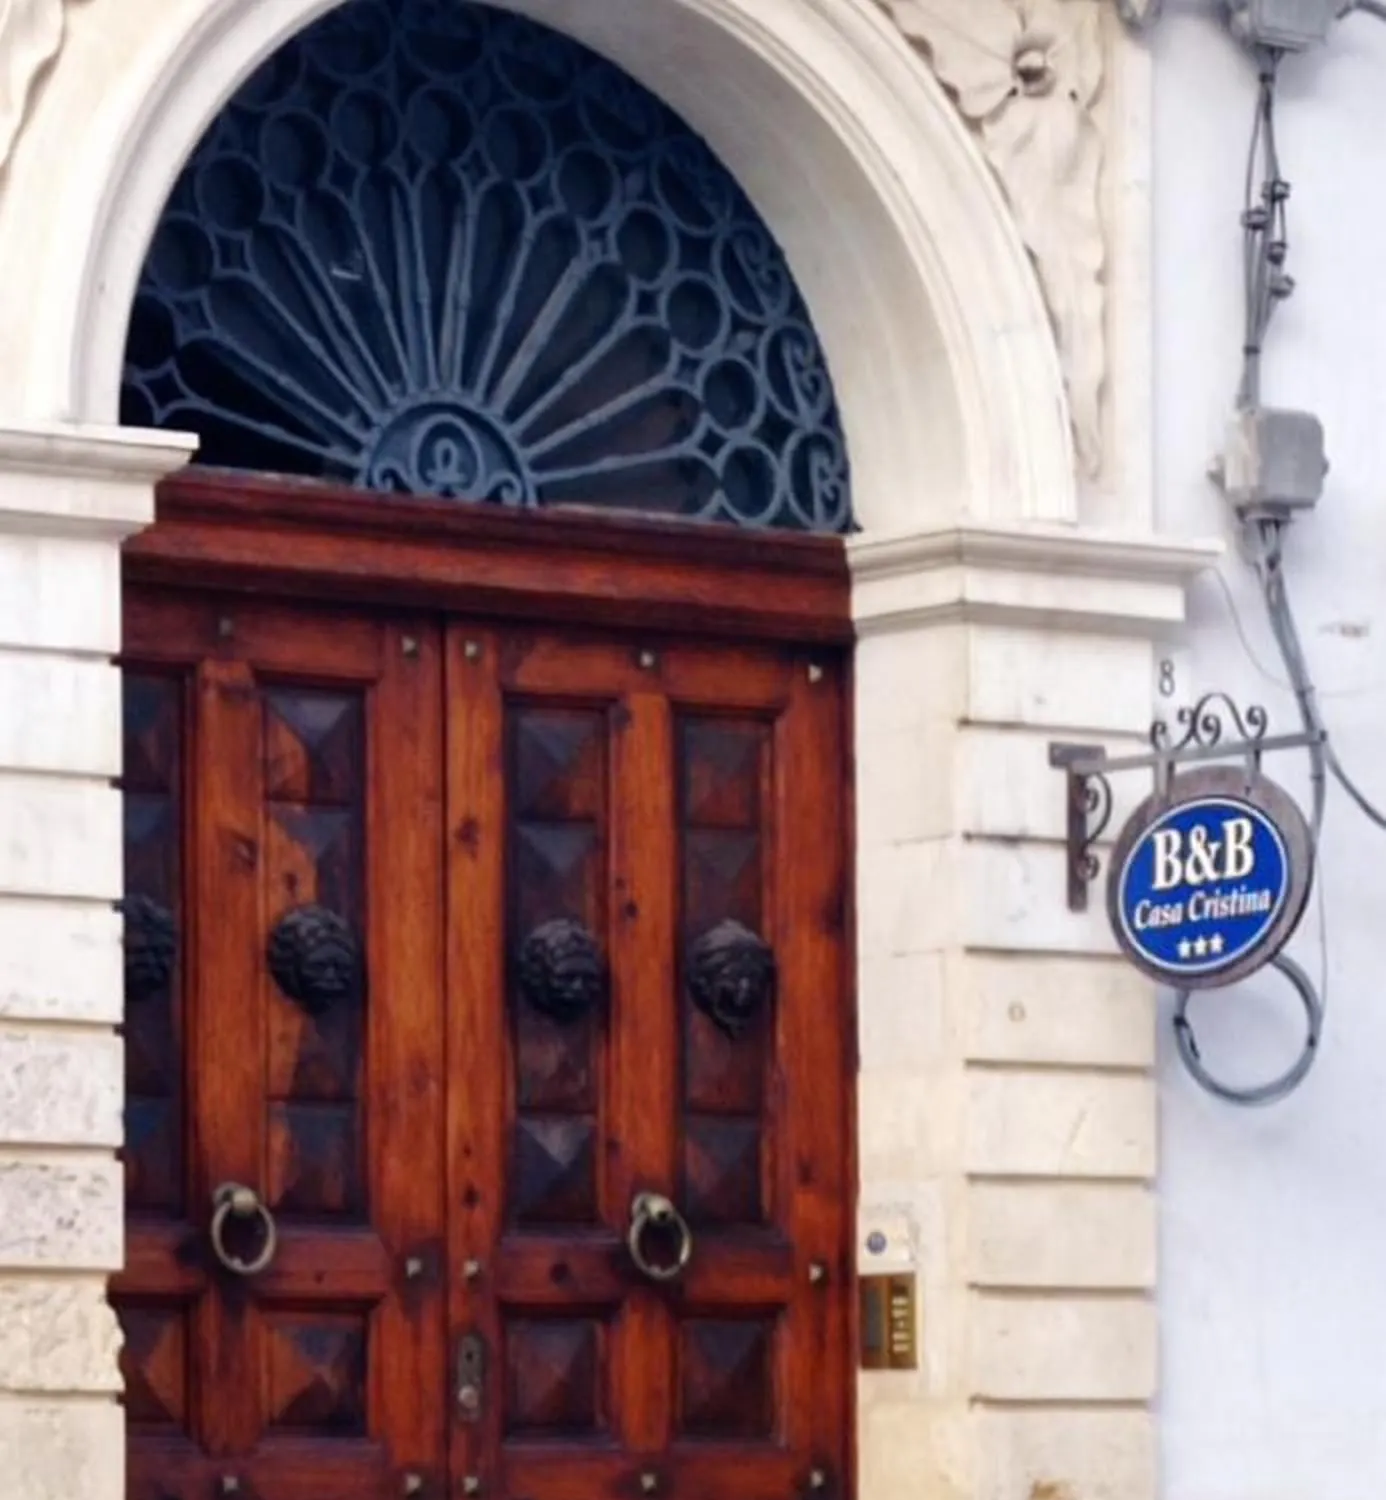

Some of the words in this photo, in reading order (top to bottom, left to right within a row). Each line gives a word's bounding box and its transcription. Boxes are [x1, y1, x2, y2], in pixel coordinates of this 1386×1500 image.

[1158, 659, 1175, 698] 8
[1151, 816, 1255, 891] B&B
[1133, 898, 1183, 931] Casa
[1188, 885, 1271, 922] Cristina
